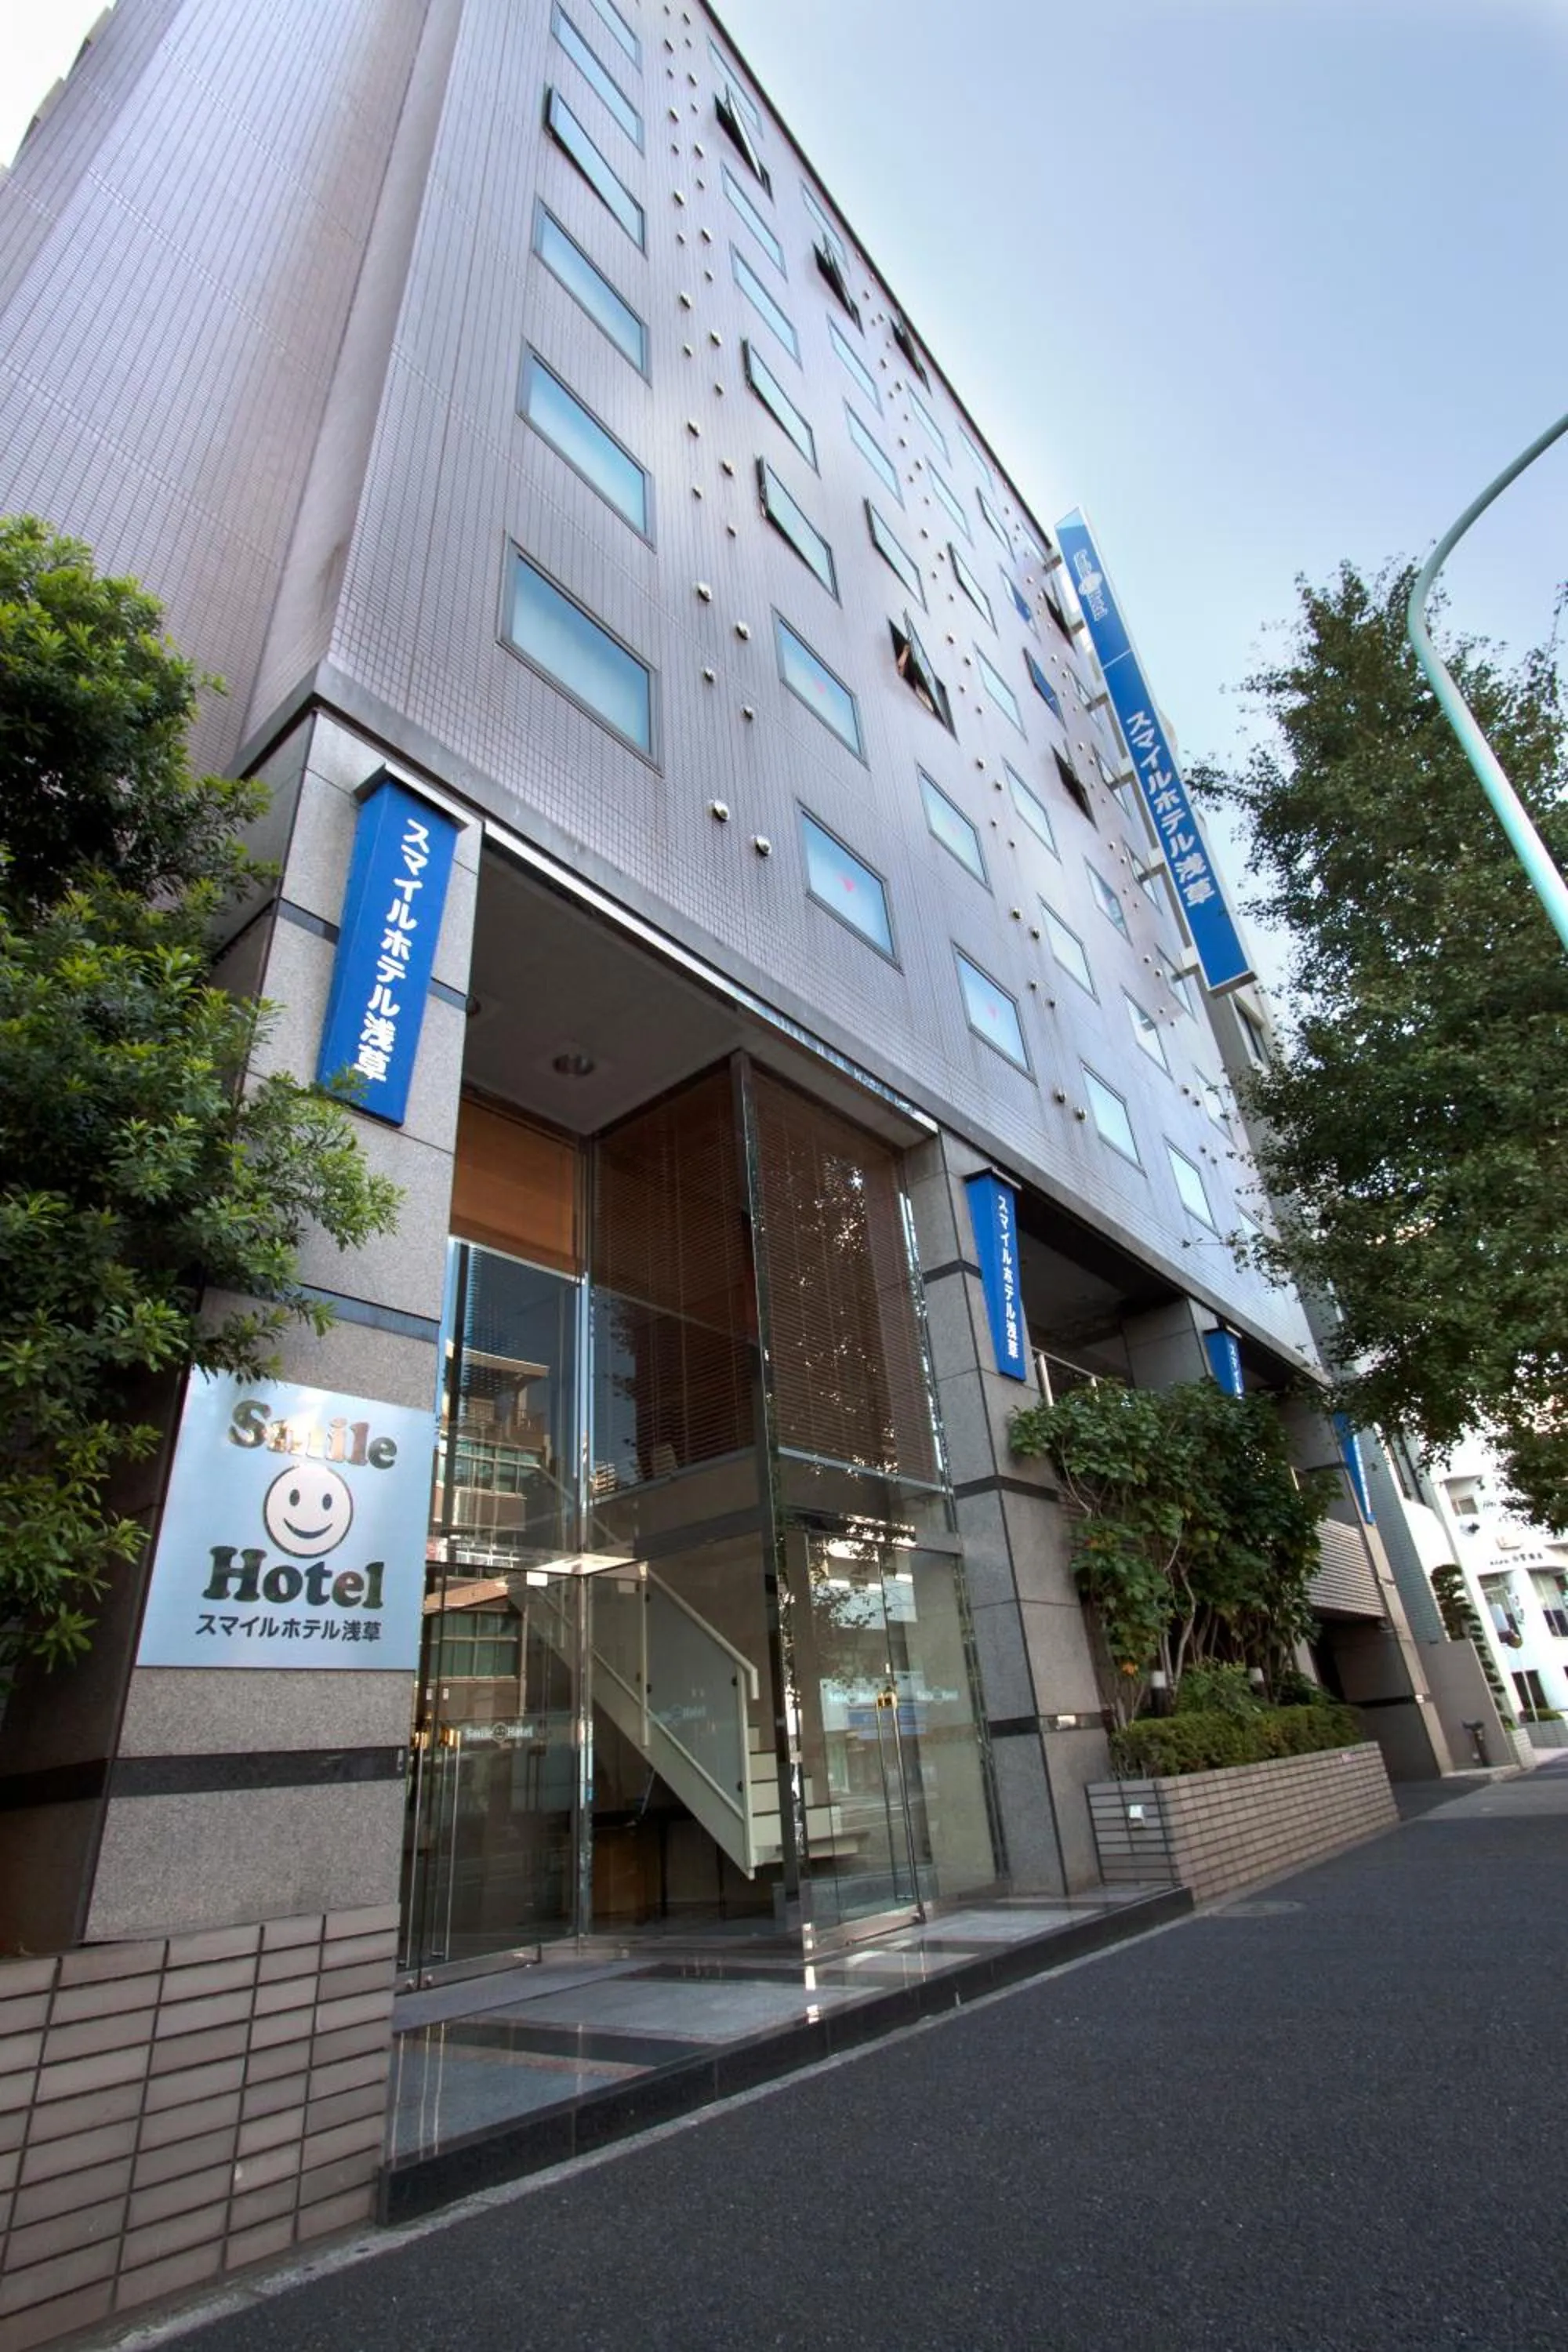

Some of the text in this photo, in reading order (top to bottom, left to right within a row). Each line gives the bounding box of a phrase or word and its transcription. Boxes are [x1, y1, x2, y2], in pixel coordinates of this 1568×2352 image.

[354, 818, 430, 1083] スマイルホテル浅草
[202, 1545, 385, 1610] Hotel
[194, 1613, 383, 1642] スマイルホテル浅草
